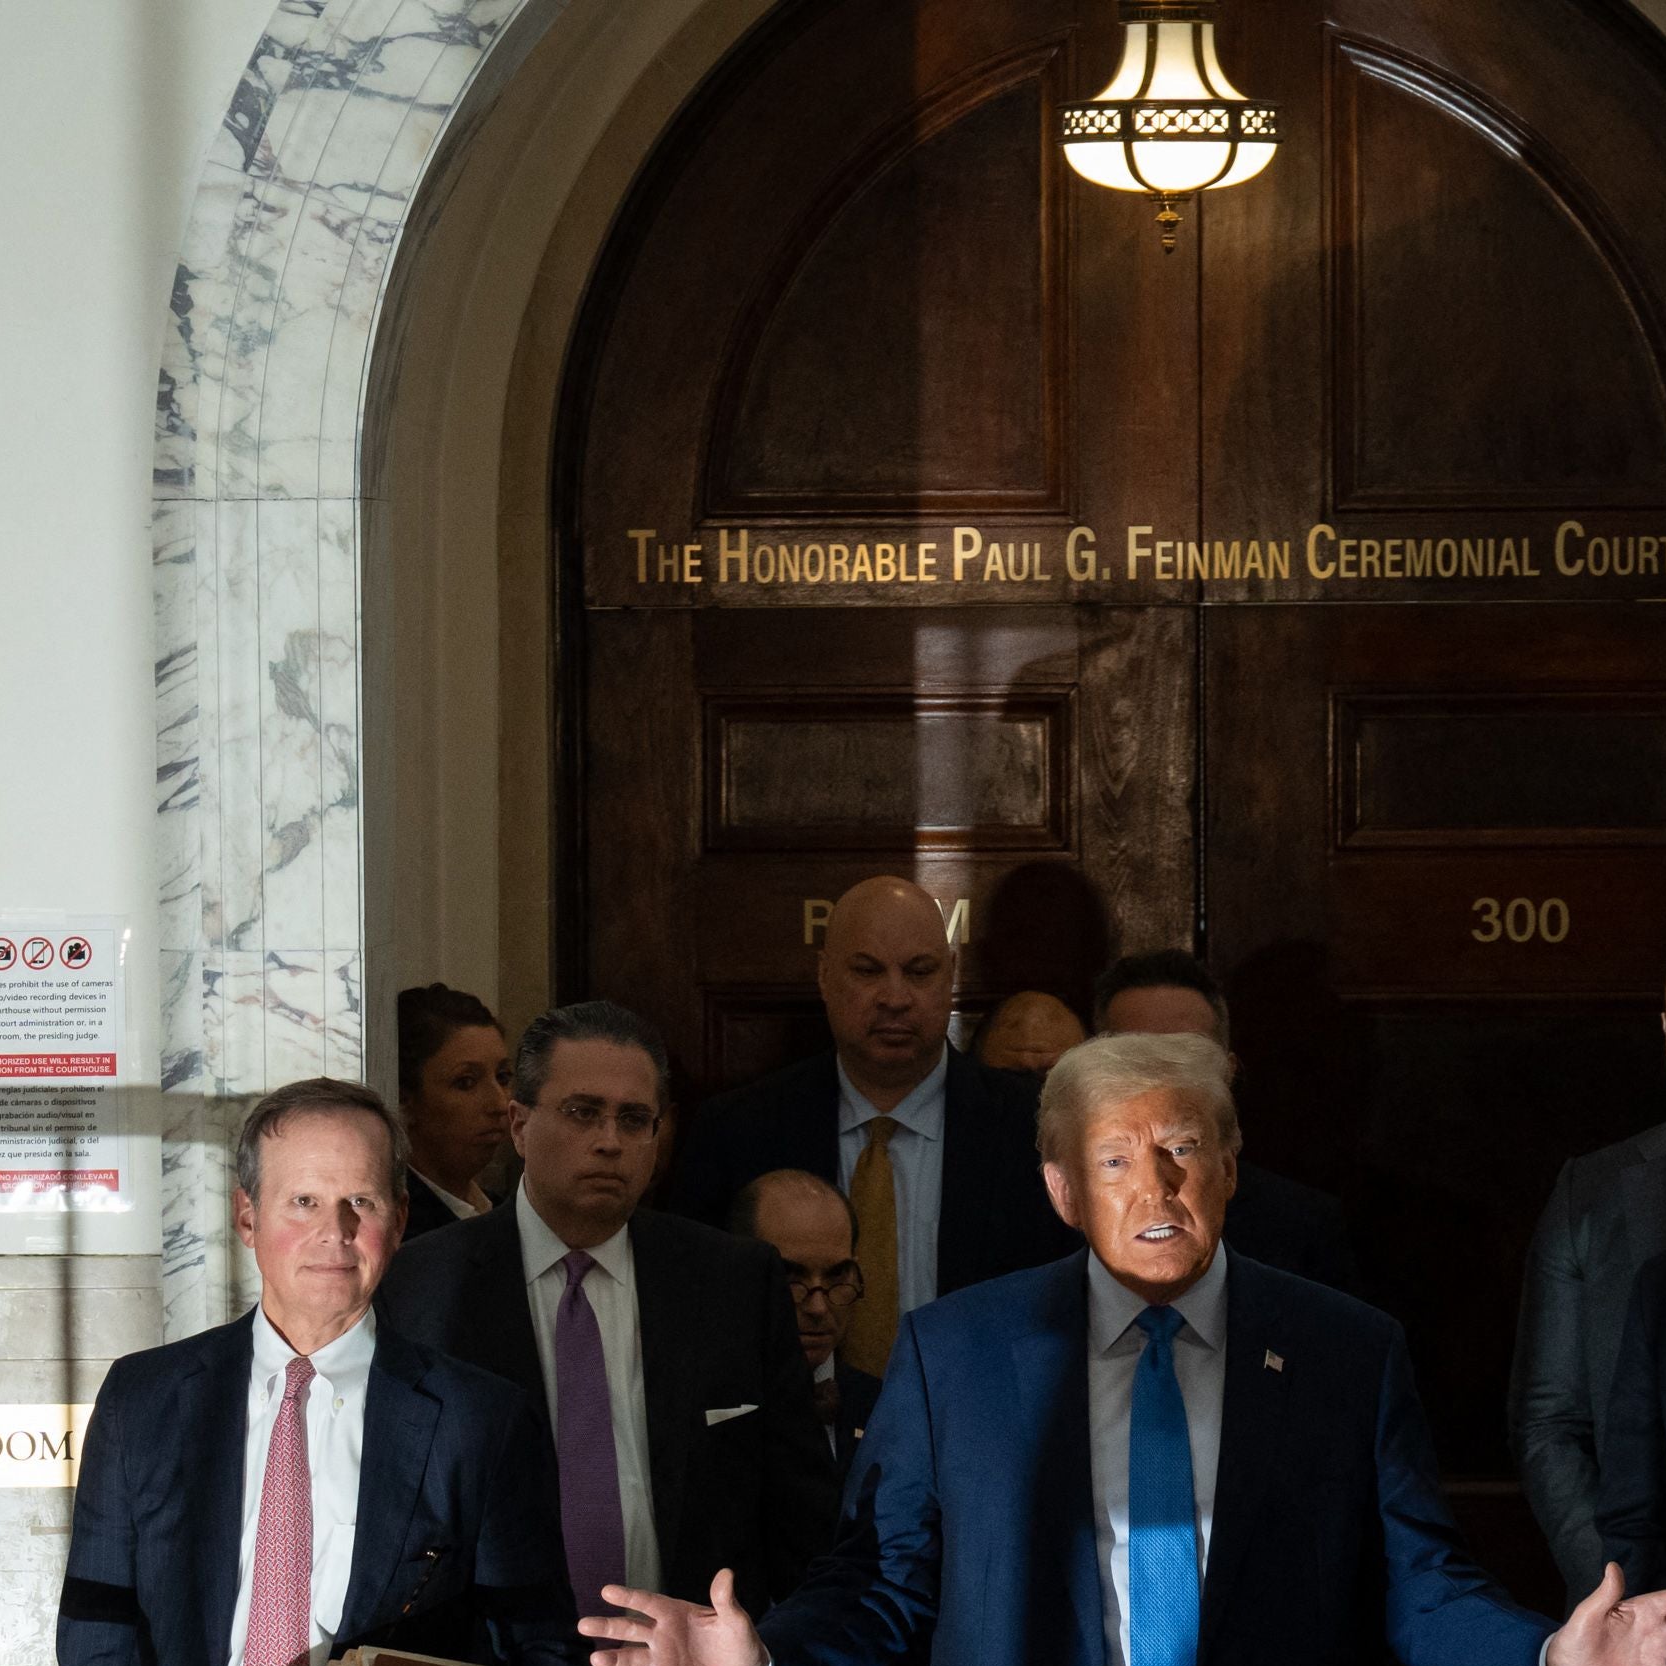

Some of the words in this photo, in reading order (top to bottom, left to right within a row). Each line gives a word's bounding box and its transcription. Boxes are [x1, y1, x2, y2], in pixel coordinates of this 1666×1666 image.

[627, 529, 702, 584] THE
[718, 527, 937, 584] HONORABLE
[953, 526, 1052, 582] PAUL
[1064, 525, 1111, 582] G.
[1127, 525, 1291, 580] FEINMAN
[1306, 523, 1540, 579] CEREMONIAL
[803, 898, 970, 945] RM
[1471, 897, 1570, 942] 300
[9, 981, 39, 989] prohibit
[30, 994, 66, 1002] recording
[65, 1006, 106, 1014] permission
[39, 1032, 73, 1041] presiding
[0, 1086, 21, 1095] reglas
[23, 1086, 59, 1094] judiciales
[51, 1098, 96, 1107] dispositivos
[37, 1111, 83, 1119] audio/visual
[1, 1124, 30, 1132] tribunal
[7, 1151, 22, 1159] que
[24, 1150, 52, 1159] presida
